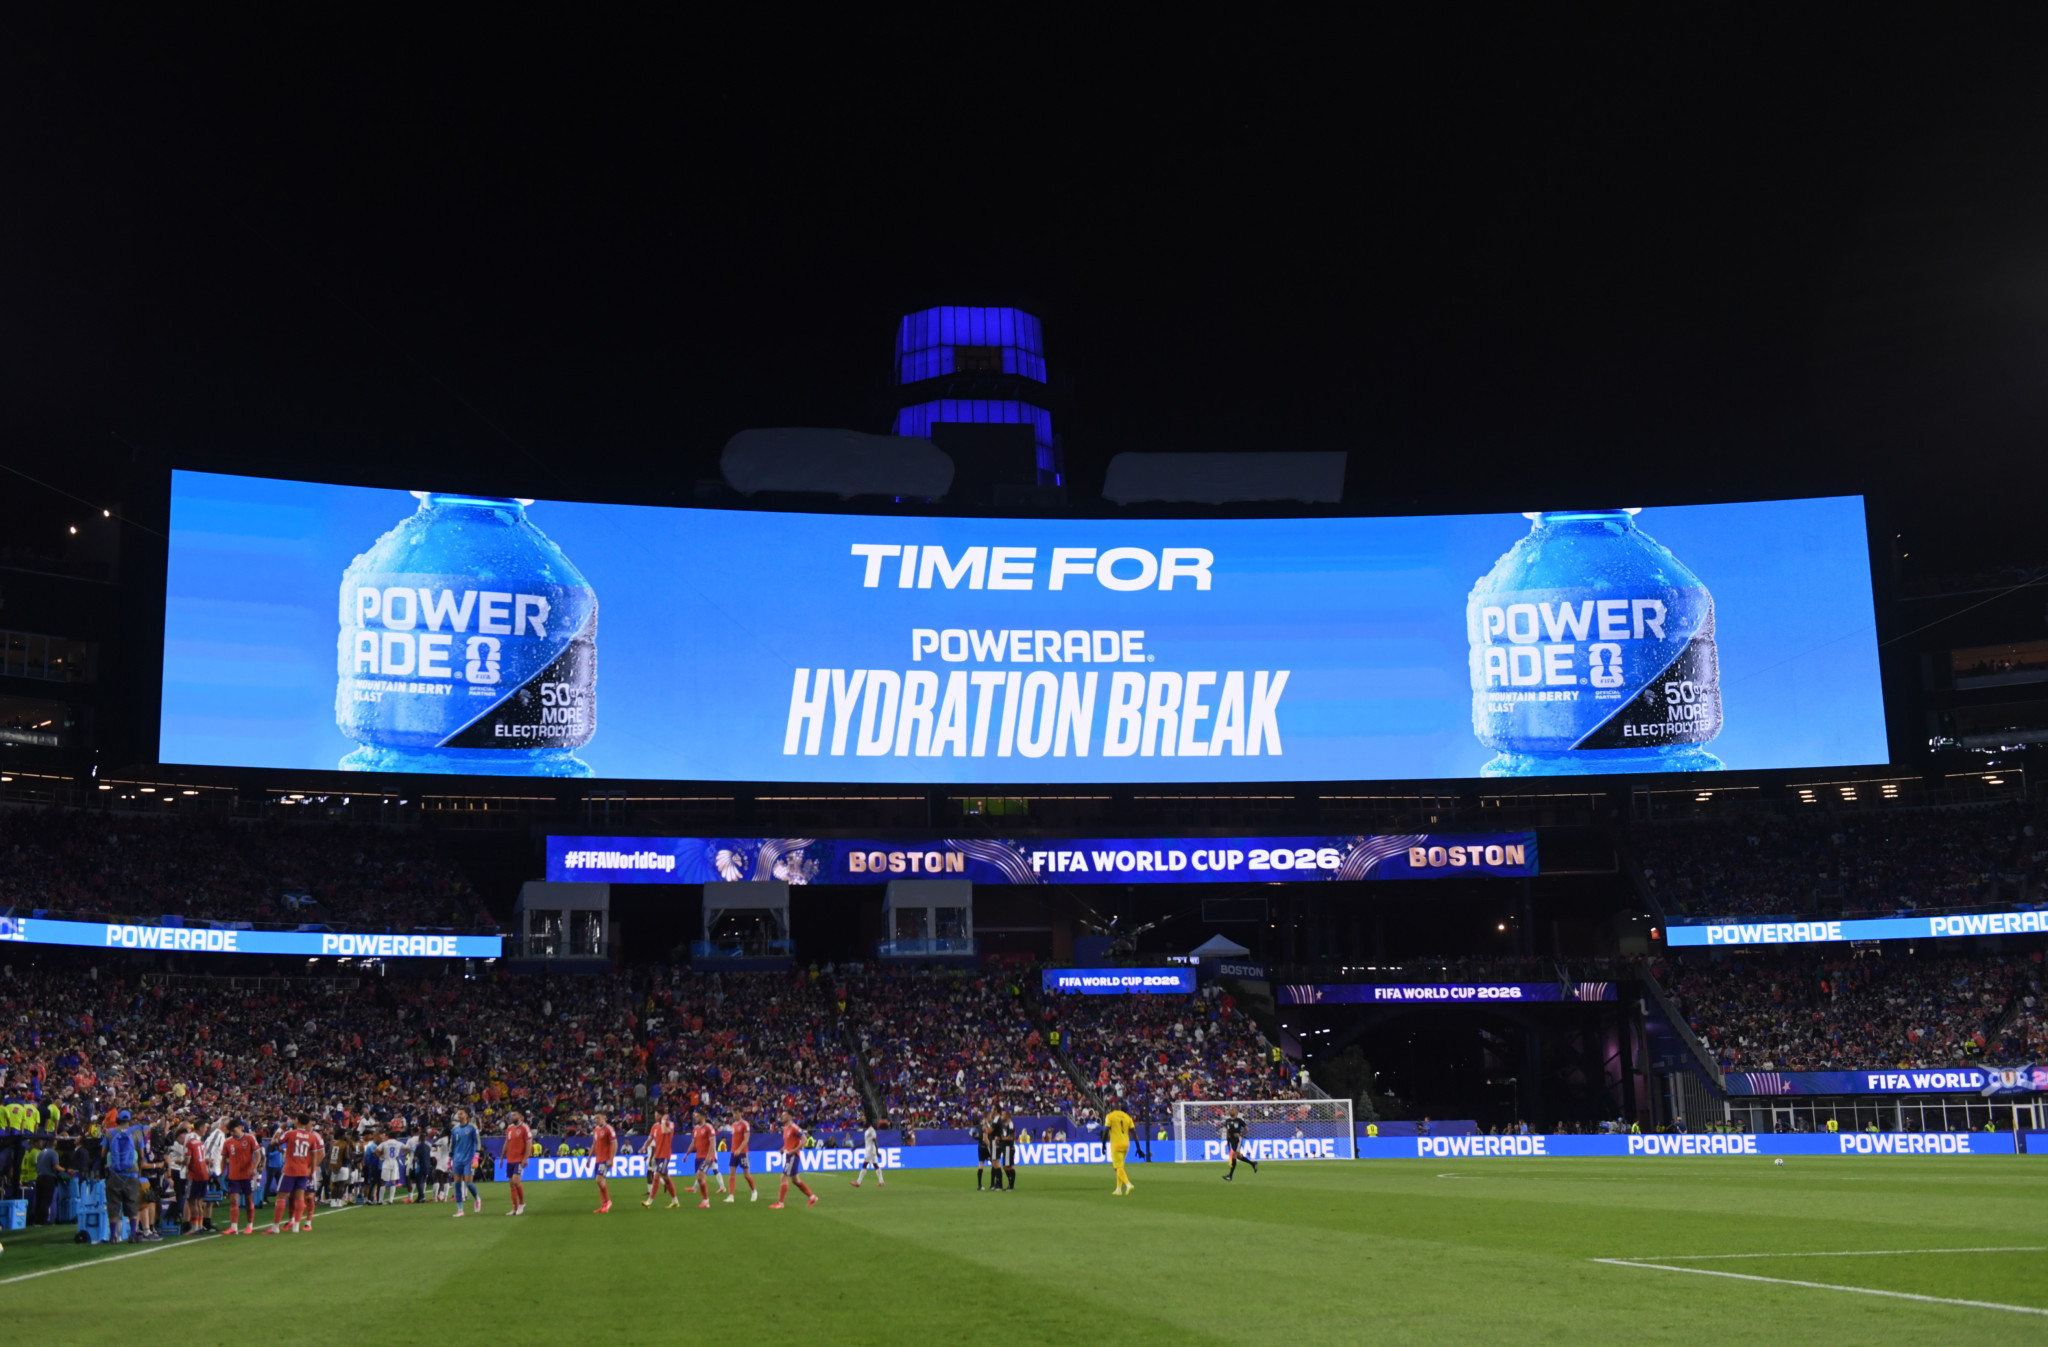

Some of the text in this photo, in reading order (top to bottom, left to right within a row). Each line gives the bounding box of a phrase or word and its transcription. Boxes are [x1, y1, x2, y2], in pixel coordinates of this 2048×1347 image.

[851, 543, 1214, 591] TIME FOR
[357, 587, 551, 640] POWER
[1483, 599, 1667, 645] POWER
[912, 628, 1146, 663] POWERADE
[409, 682, 453, 695] BERRY
[1538, 690, 1580, 701] BERRY
[542, 707, 583, 724] MORE
[783, 668, 1291, 758] HYDRATION BREAK
[1668, 703, 1709, 721] MORE
[565, 851, 676, 872] #FIFAWorldCup
[848, 851, 965, 874] BOSTON
[1032, 848, 1341, 872] FIFA WORLD CUP 2026
[1408, 845, 1525, 867] BOSTON
[1707, 921, 1843, 944] POWERADE
[1930, 911, 2048, 936] POWERAD
[106, 925, 238, 952] POWERADE
[322, 934, 458, 956] POWERADE
[1059, 976, 1180, 987] FIFA WORLD CUP 2026
[1220, 964, 1264, 977] BOSTON
[1374, 986, 1522, 999] FIFA WORLD CUP 2026
[1868, 1074, 1910, 1089] FIFA
[1912, 1072, 1985, 1089] WORLD
[293, 1139, 310, 1157] 10
[988, 1142, 1113, 1165] WERAD
[1417, 1136, 1546, 1157] POWERADE
[1628, 1134, 1757, 1155] POWERADE
[1840, 1134, 1971, 1153] POWERADE
[538, 1155, 677, 1179] POWRAE
